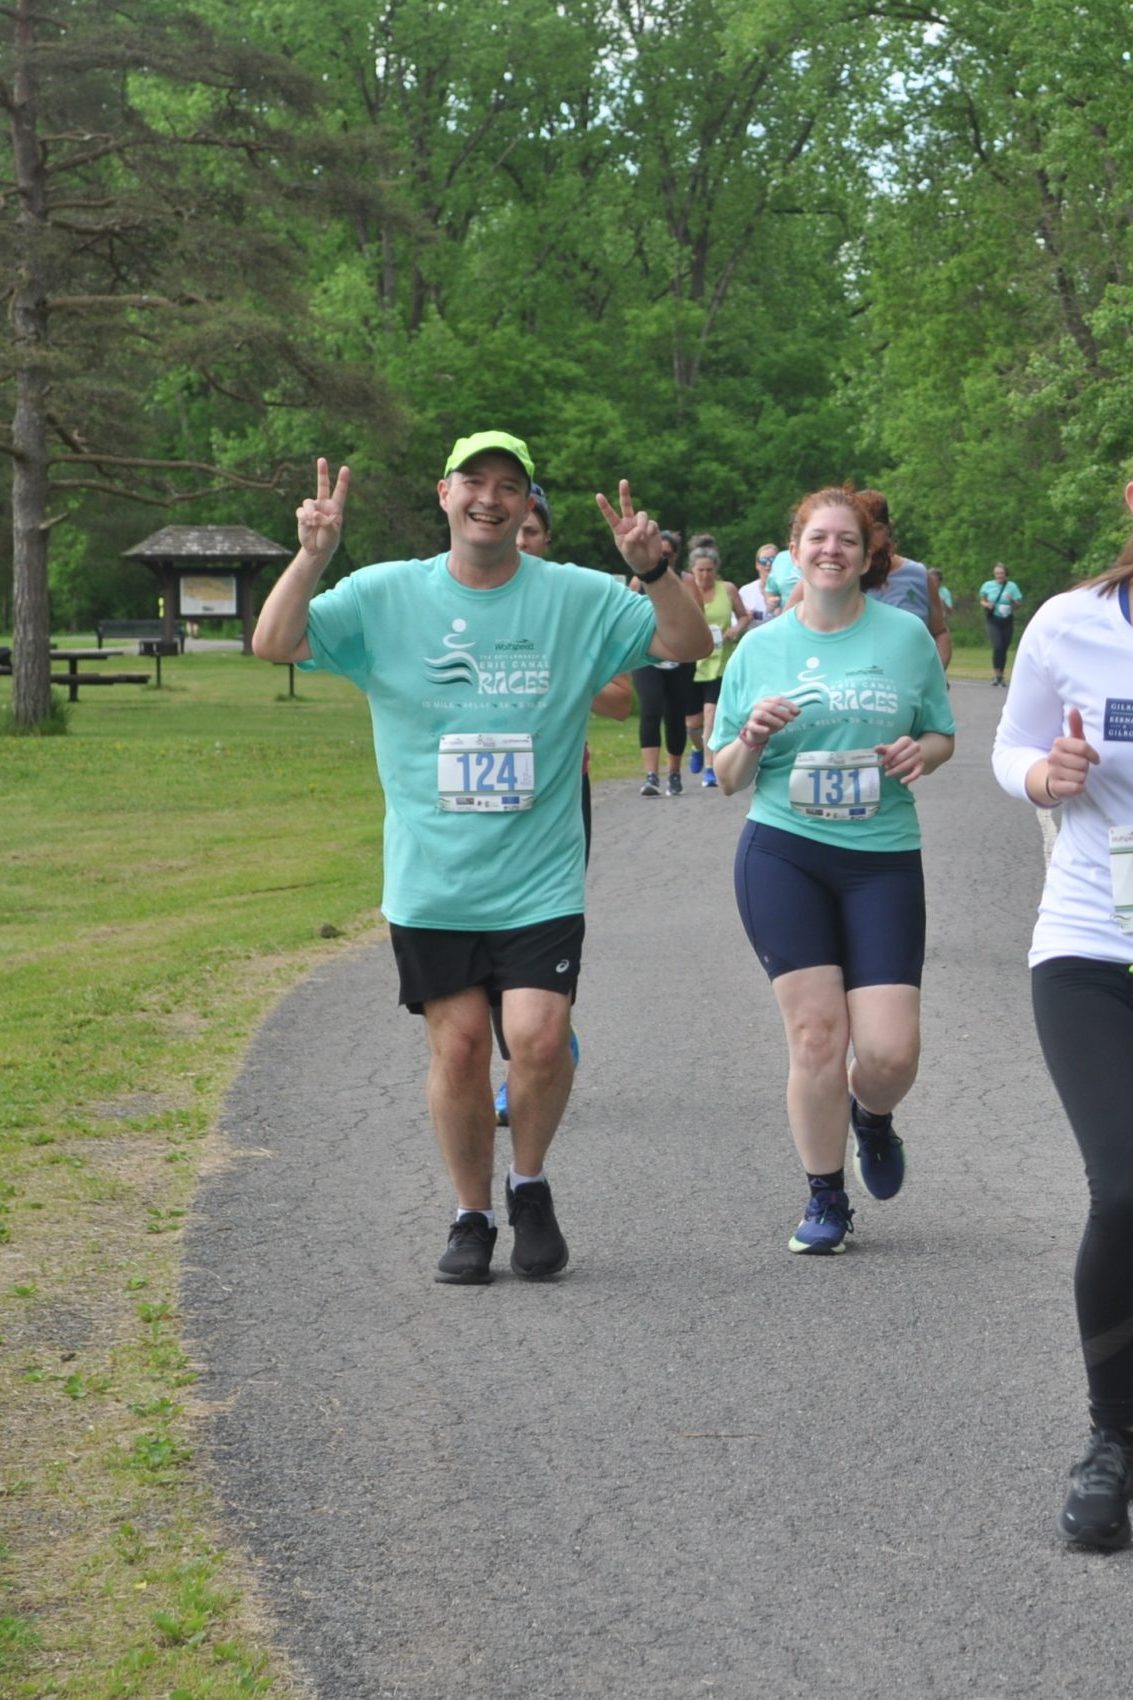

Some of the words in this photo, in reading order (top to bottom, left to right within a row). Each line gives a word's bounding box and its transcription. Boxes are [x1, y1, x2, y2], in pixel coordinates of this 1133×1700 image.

[479, 660, 507, 669] ERIE
[511, 660, 550, 669] CANAL
[477, 670, 550, 695] RACES
[829, 690, 898, 714] RACES
[456, 752, 518, 792] 124
[808, 768, 861, 805] 131
